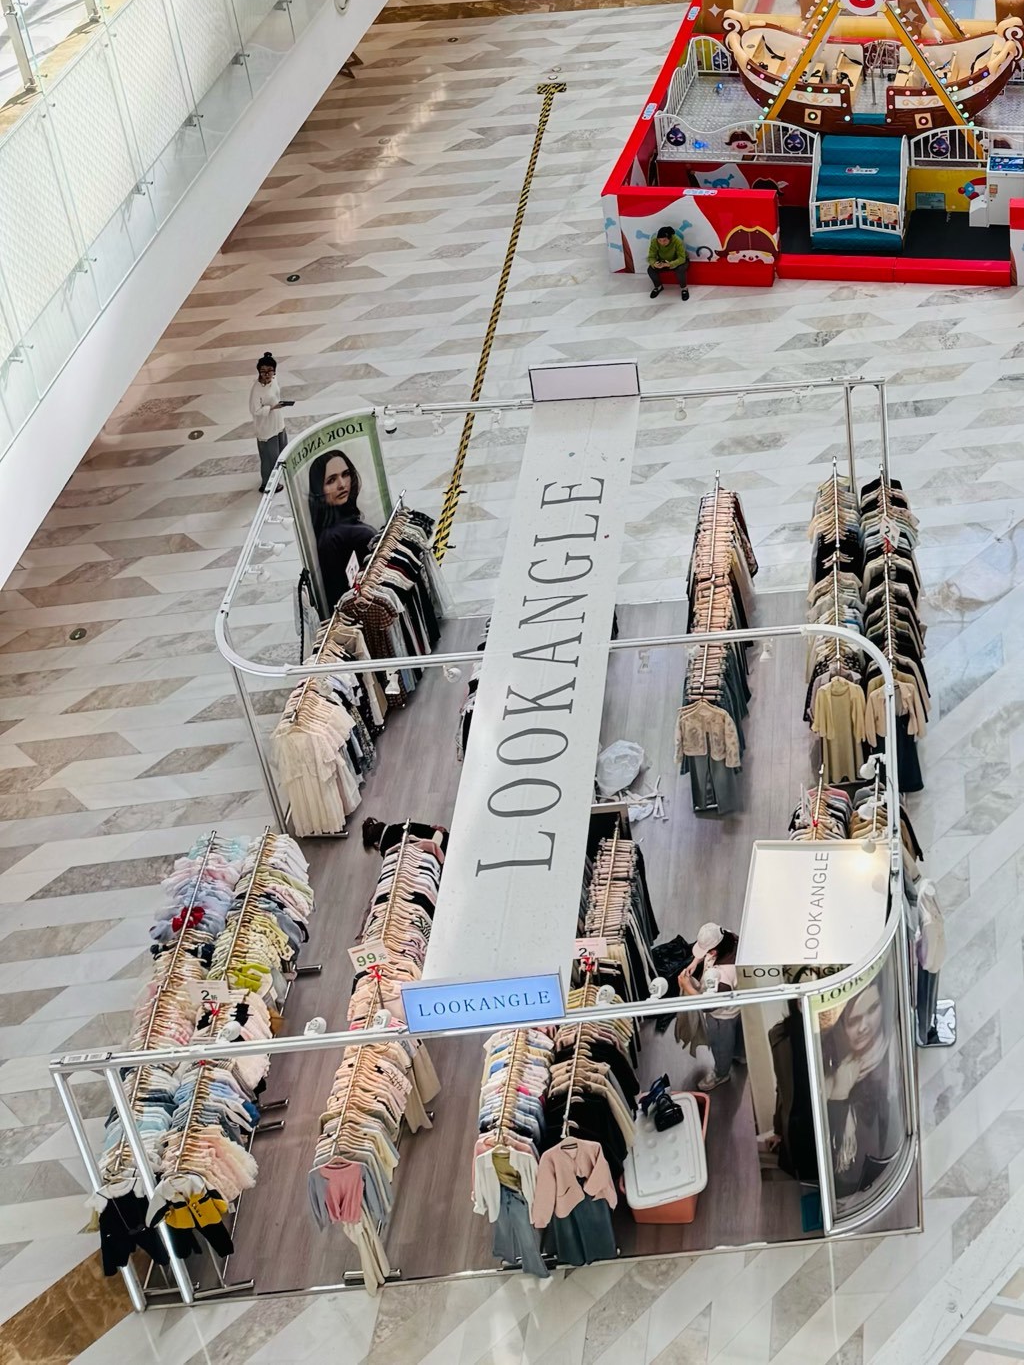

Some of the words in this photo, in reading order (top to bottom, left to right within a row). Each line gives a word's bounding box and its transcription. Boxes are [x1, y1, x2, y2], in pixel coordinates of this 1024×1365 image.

[475, 476, 605, 877] LOOKANGLE
[742, 967, 793, 978] LOOK
[418, 990, 551, 1017] LOOKANGLE
